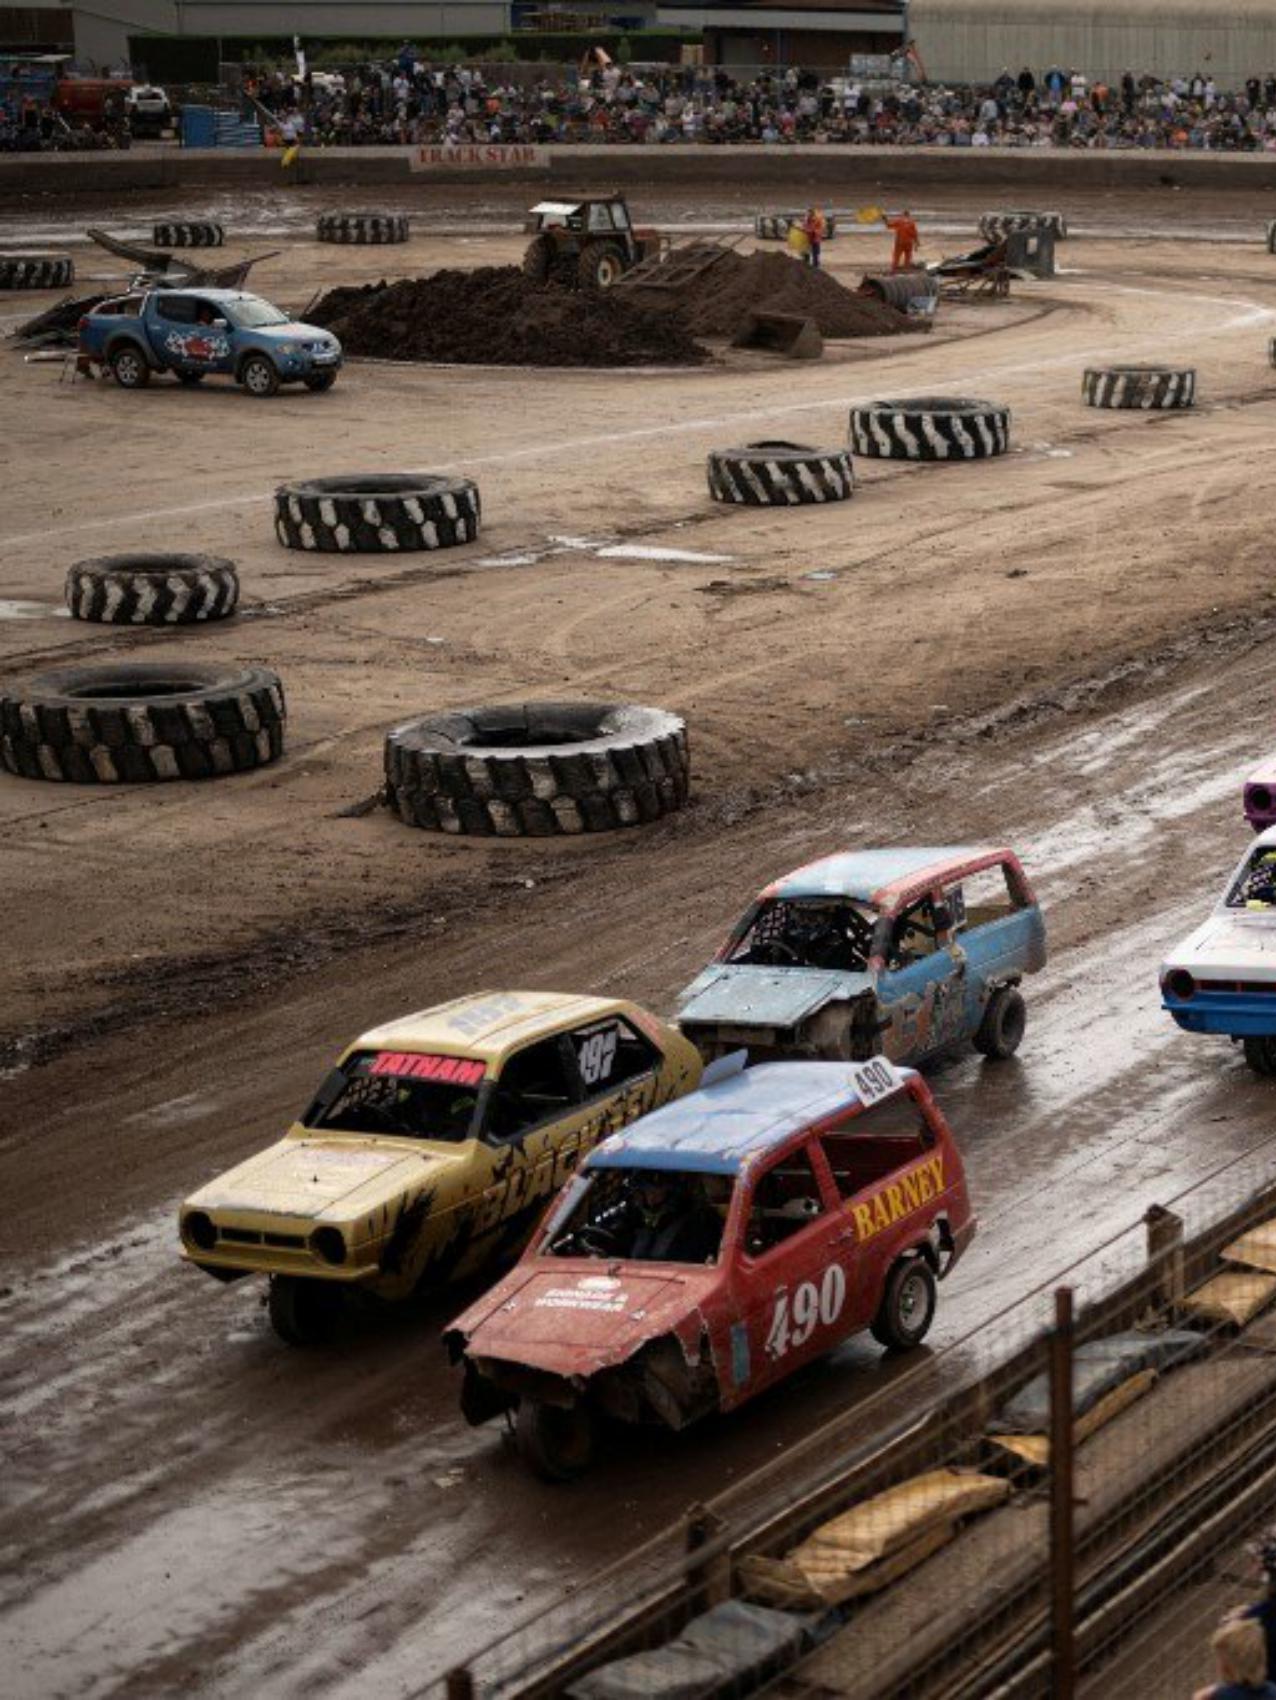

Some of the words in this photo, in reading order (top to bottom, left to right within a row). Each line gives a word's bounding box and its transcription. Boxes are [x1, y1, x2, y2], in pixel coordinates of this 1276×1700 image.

[486, 147, 536, 162] STAR
[370, 1052, 486, 1085] TATHAM
[578, 1031, 617, 1085] 197
[855, 1061, 893, 1098] 490
[853, 1157, 947, 1243] BARNEY
[764, 1263, 846, 1361] 490
